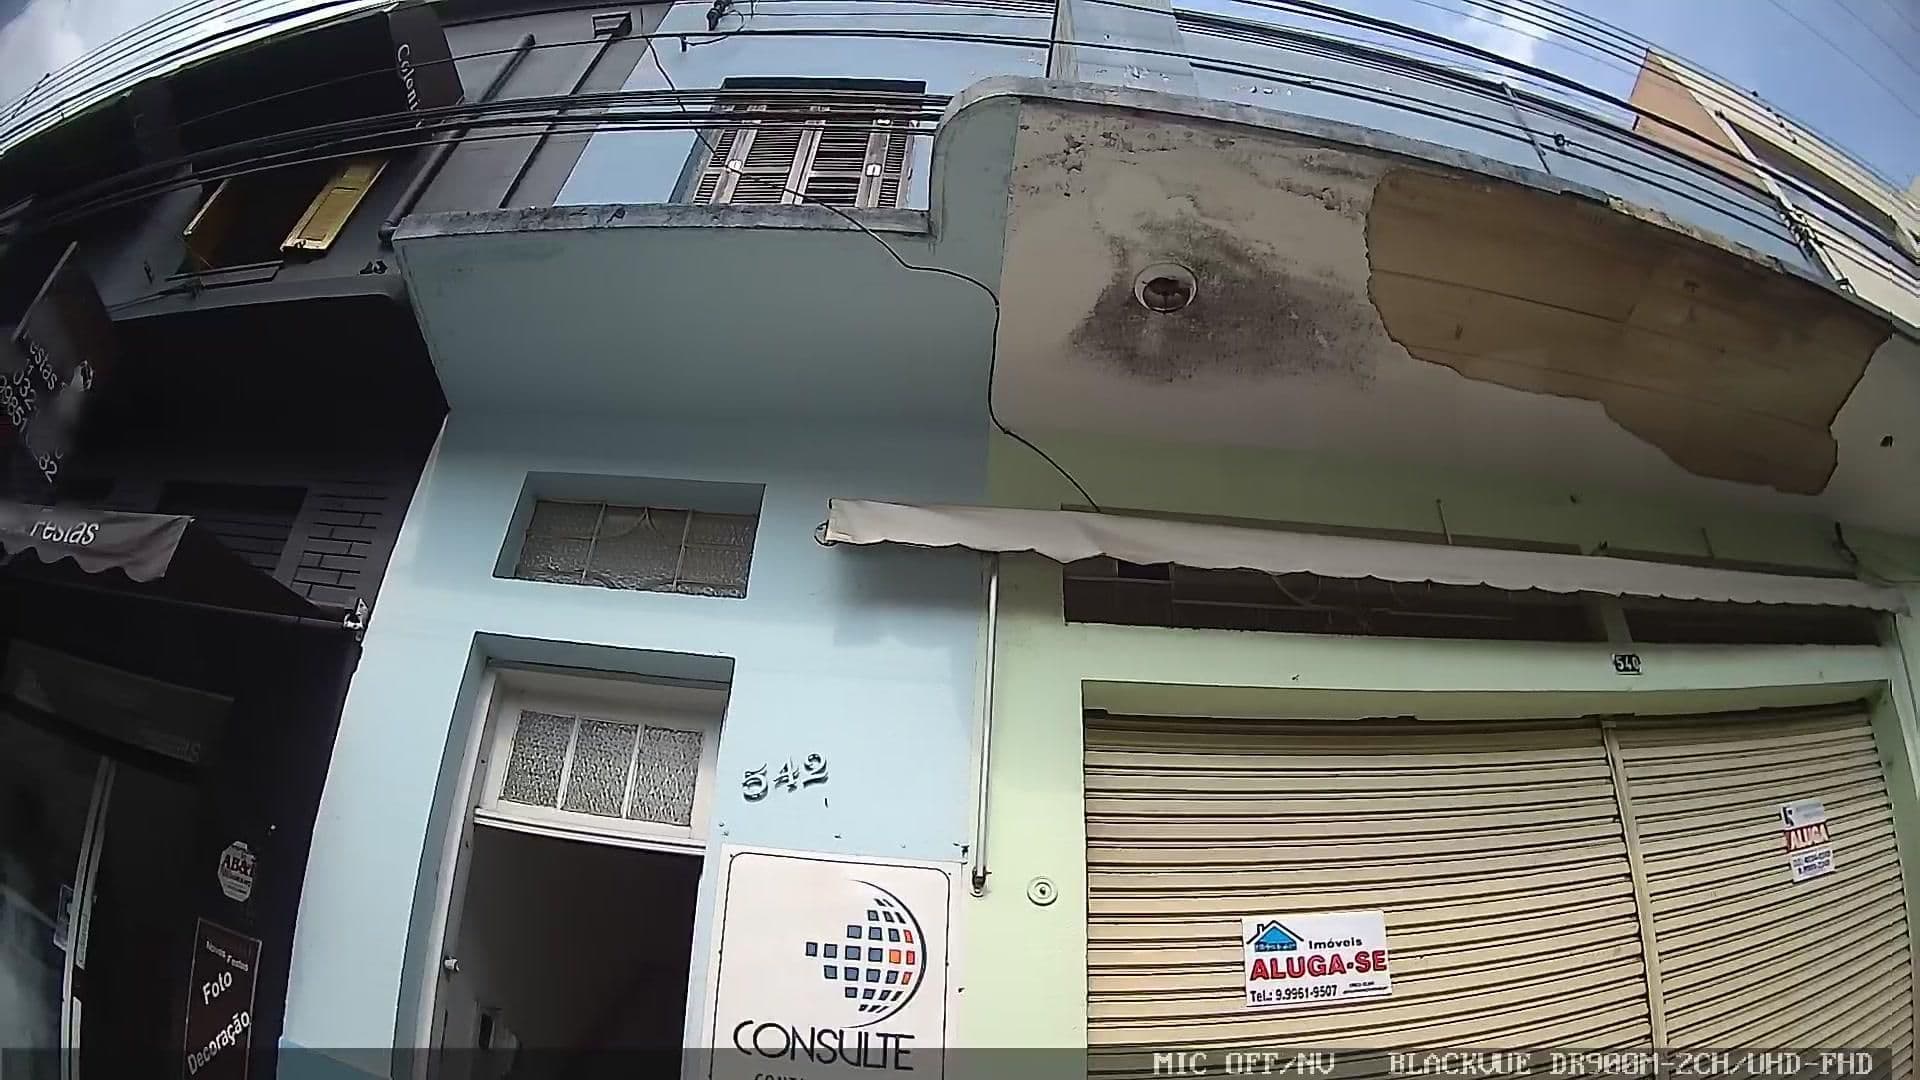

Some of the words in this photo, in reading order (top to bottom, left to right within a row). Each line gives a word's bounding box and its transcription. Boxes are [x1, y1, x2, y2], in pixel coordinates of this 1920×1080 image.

[742, 753, 829, 803] 542
[1308, 936, 1363, 950] Imóveis
[202, 971, 233, 1005] Foto
[187, 1010, 251, 1075] Decoração
[732, 1019, 915, 1071] CONSULTE
